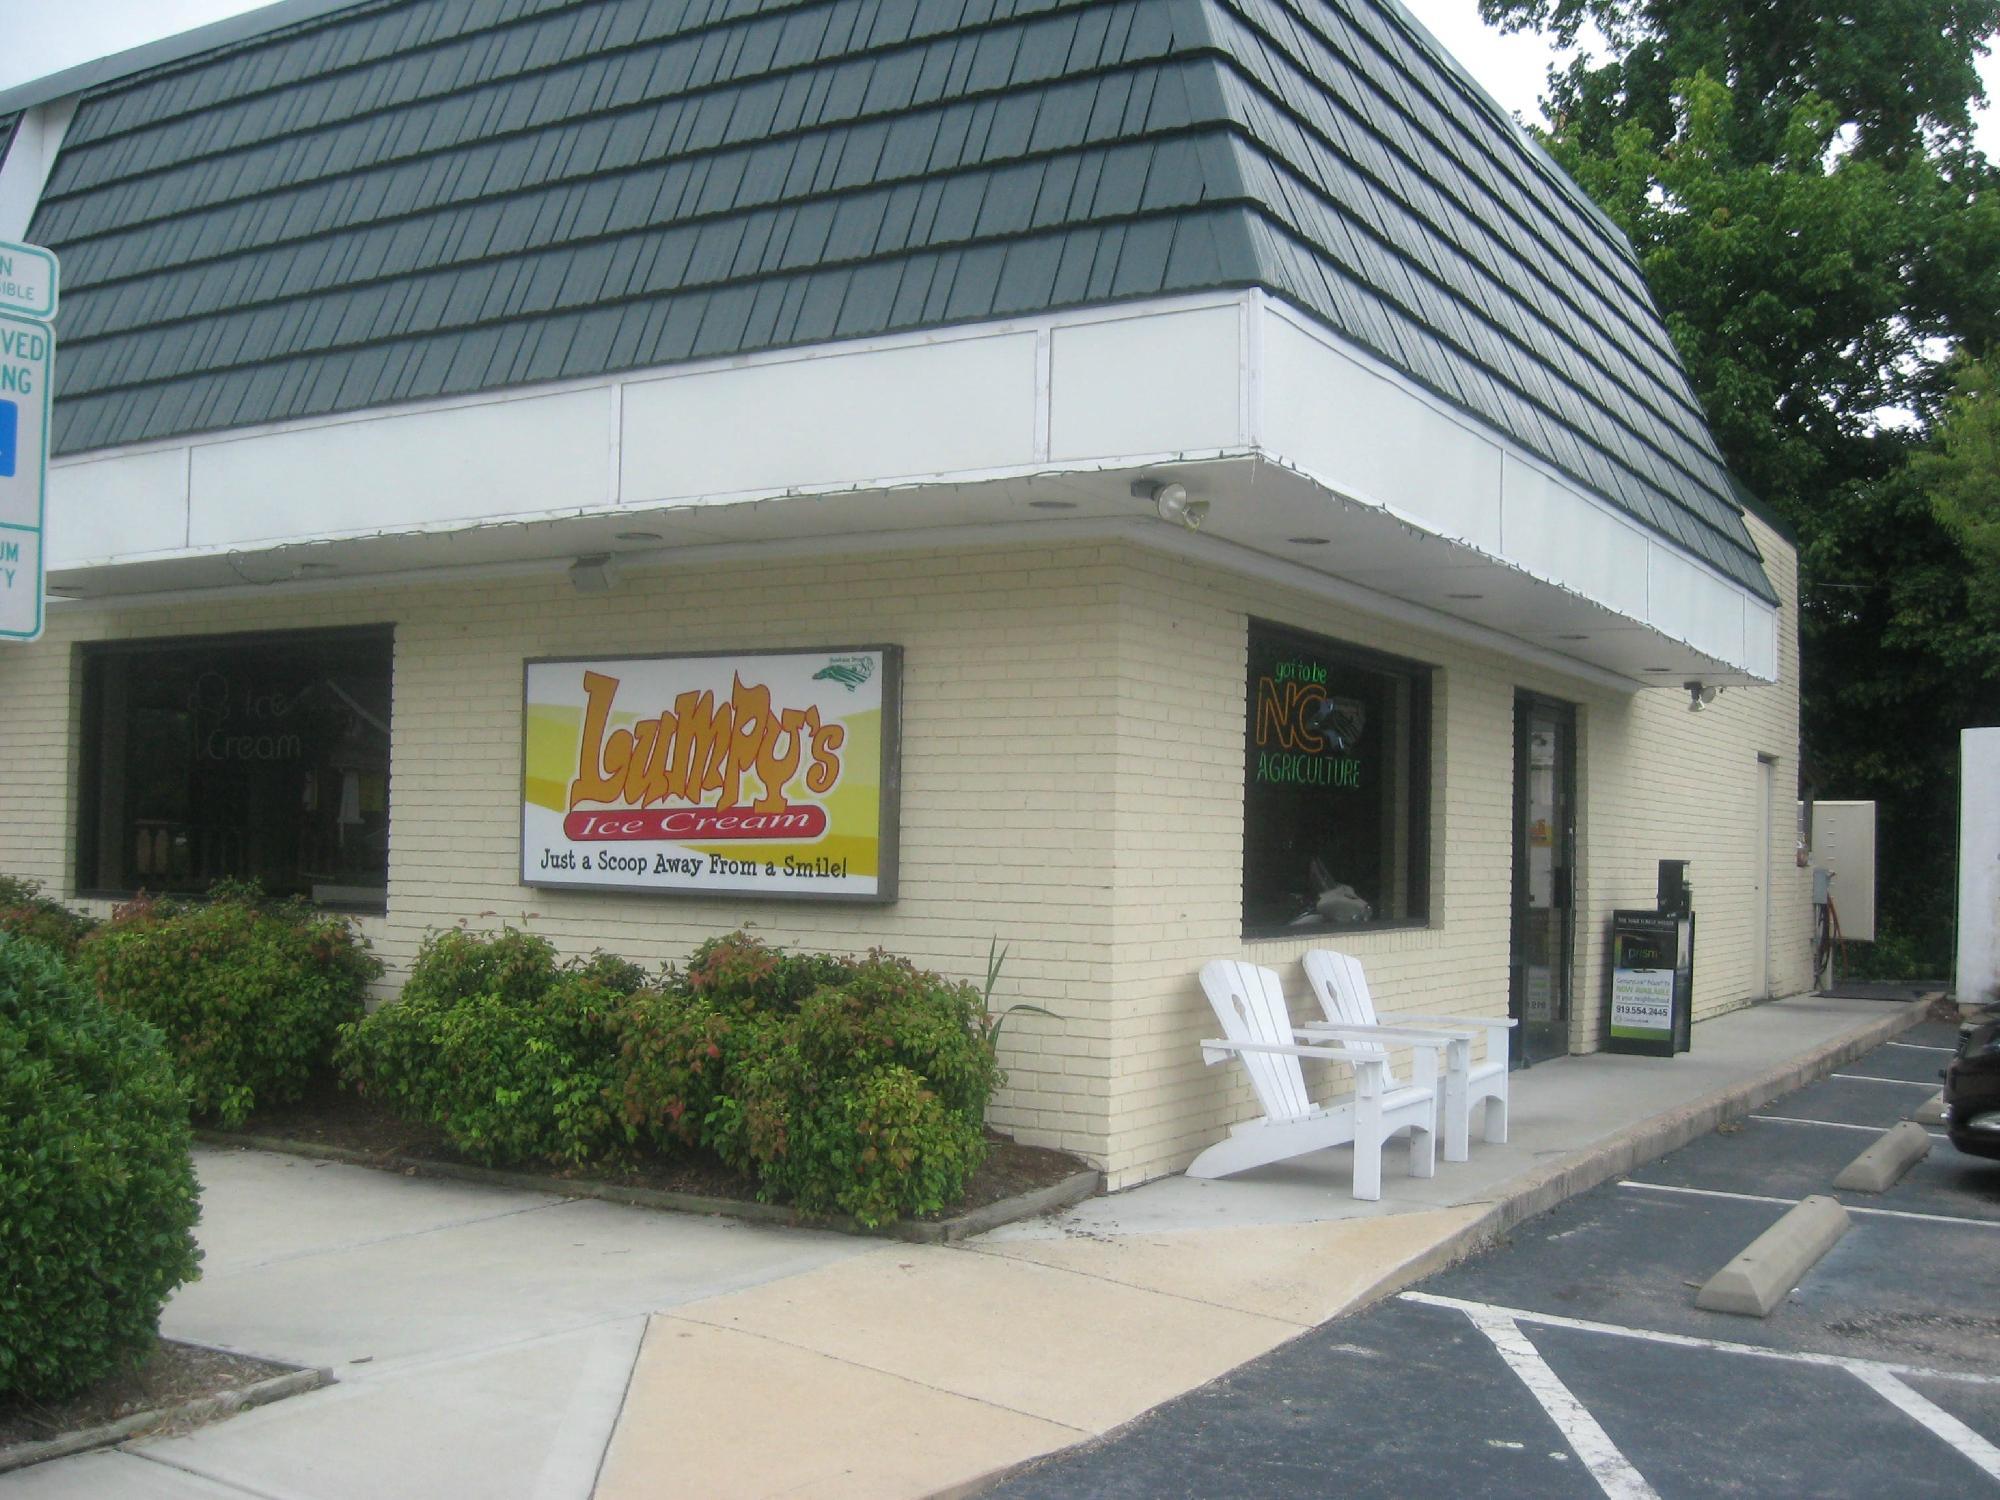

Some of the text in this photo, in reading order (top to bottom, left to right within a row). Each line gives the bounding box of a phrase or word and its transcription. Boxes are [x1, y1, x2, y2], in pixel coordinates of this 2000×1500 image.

[0, 281, 35, 301] IBLE
[2, 364, 32, 394] NG
[1257, 676, 1327, 753] NC
[208, 728, 302, 760] Cream
[570, 669, 844, 813] Lumpy's
[1257, 752, 1360, 788] AGRICULTURE
[580, 811, 810, 835] Ice Cream
[540, 848, 847, 878] Just a Scoop Away From a Smile!
